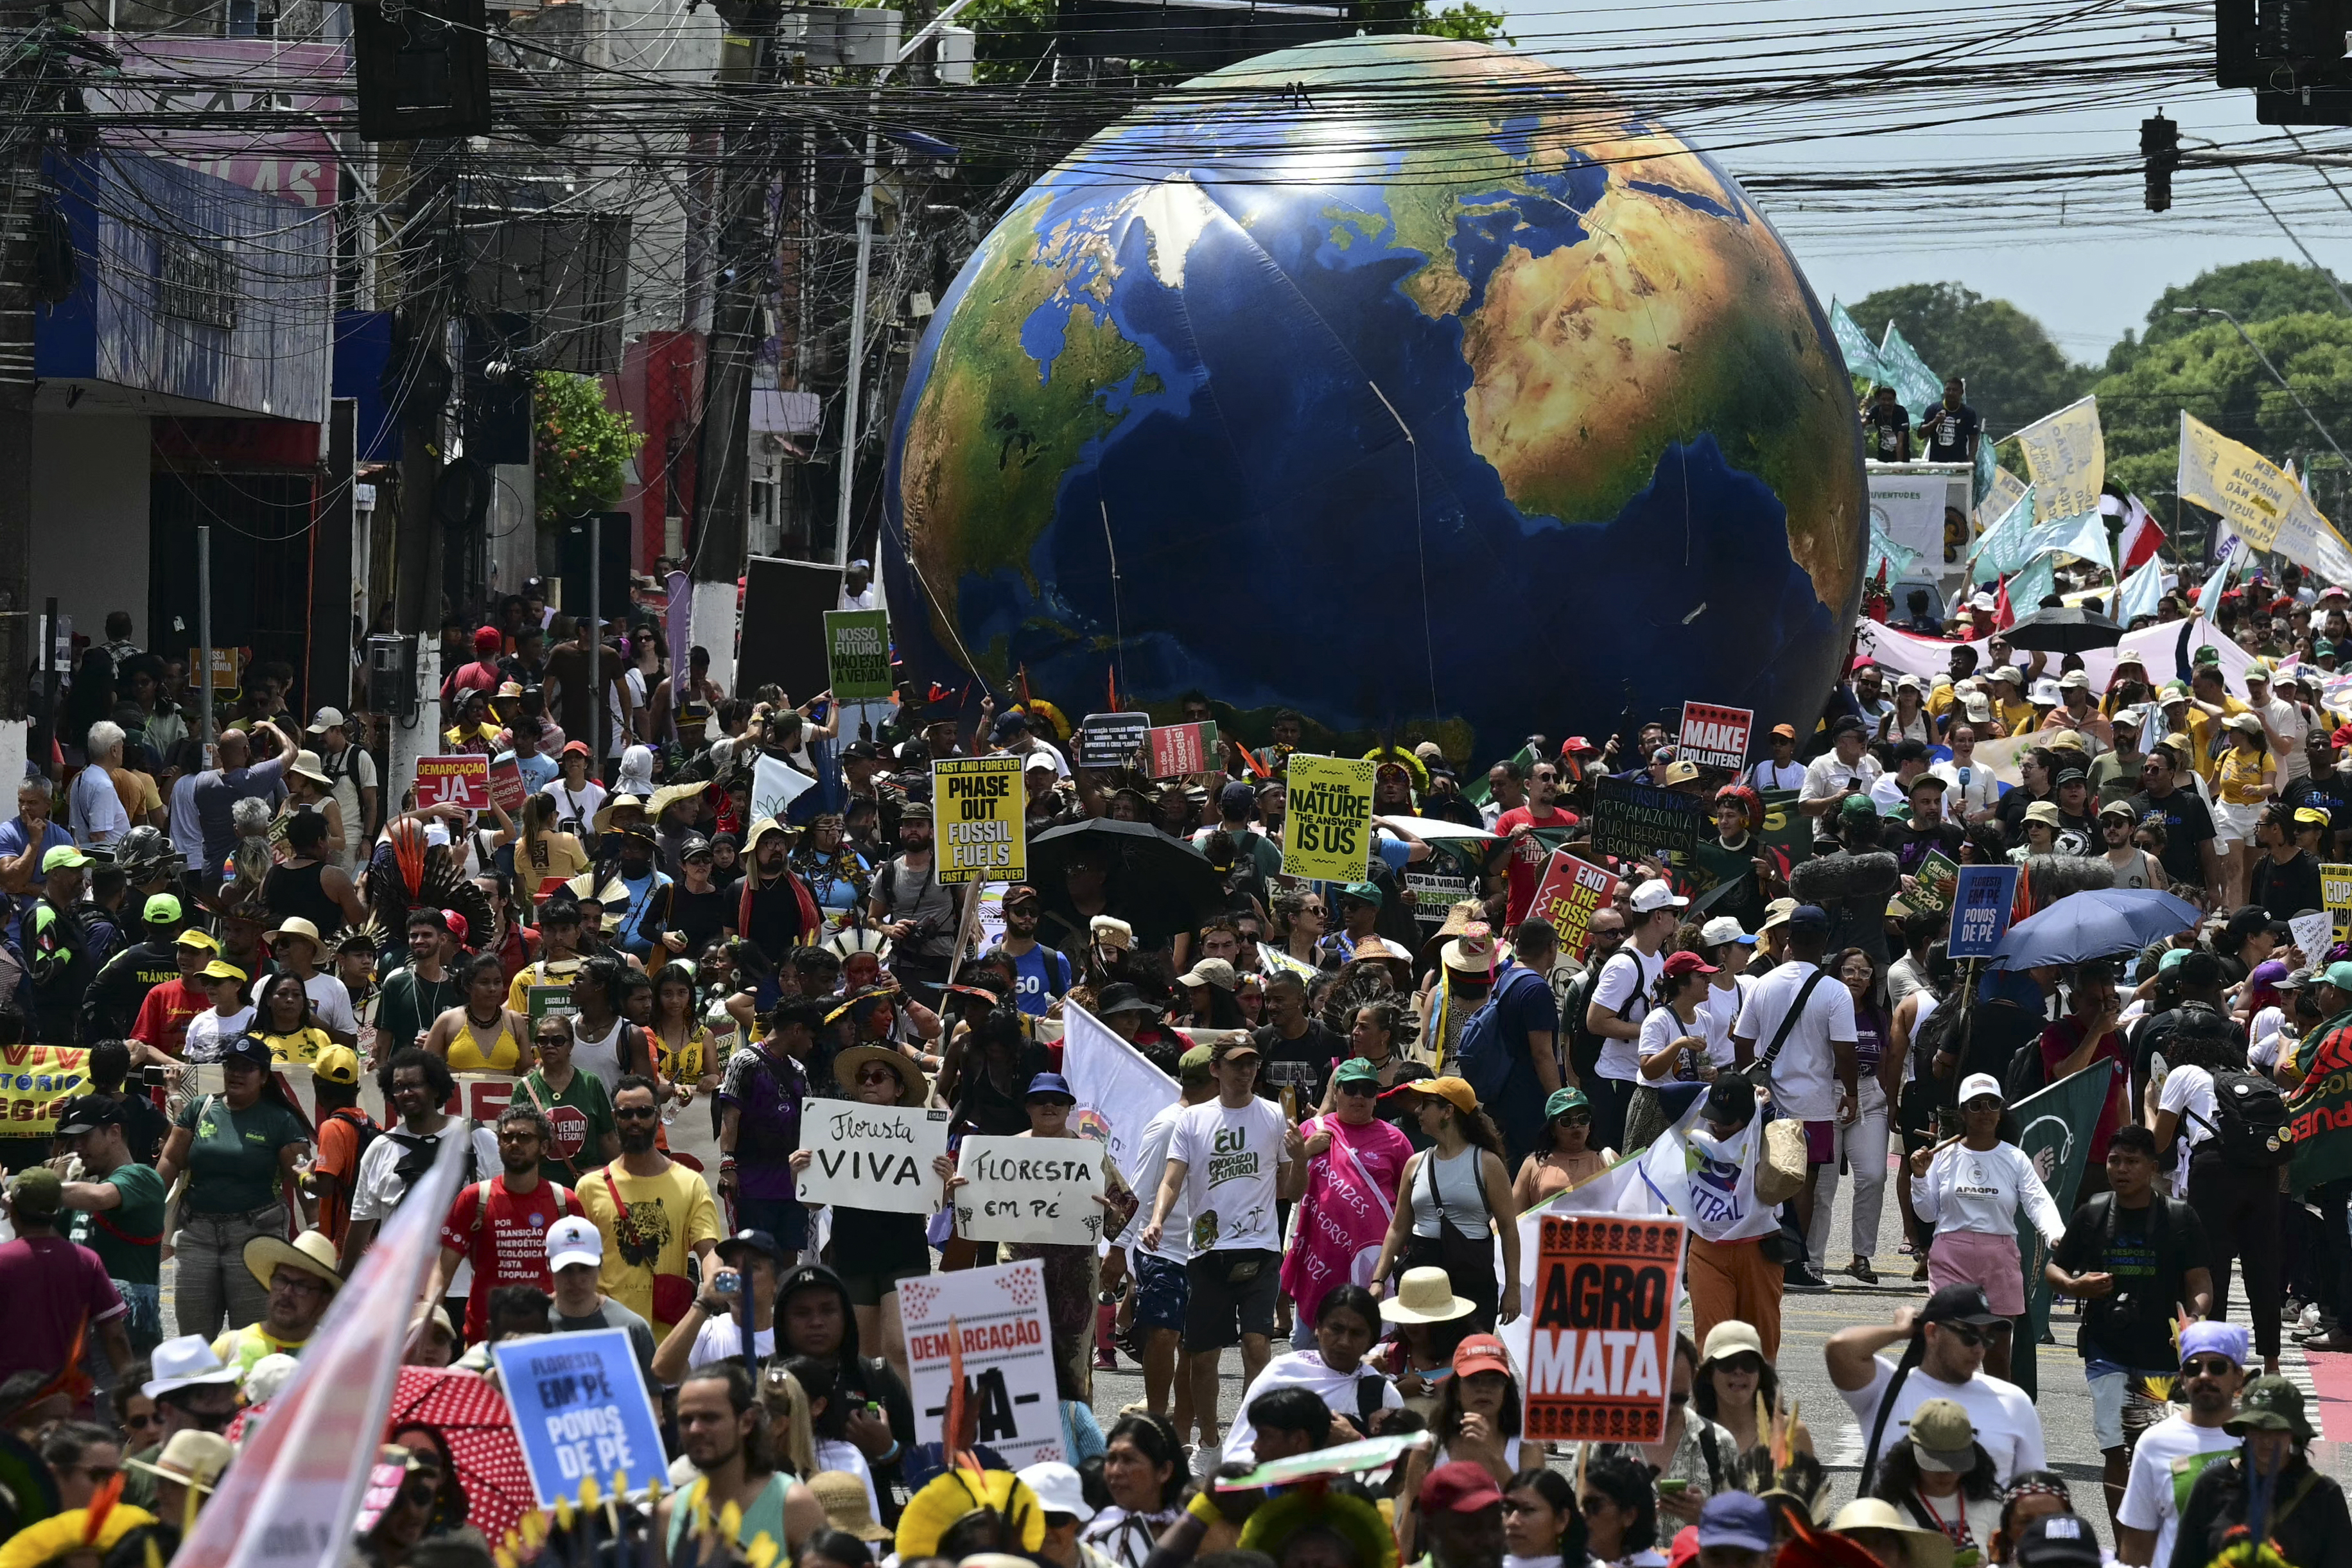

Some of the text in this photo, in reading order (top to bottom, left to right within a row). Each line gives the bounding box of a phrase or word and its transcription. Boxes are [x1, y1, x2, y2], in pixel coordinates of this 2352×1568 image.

[836, 627, 878, 641] NOSSO
[835, 641, 882, 655] FUTURO
[846, 668, 887, 683] VENDA
[1683, 719, 1746, 753] MAKE
[419, 763, 486, 776] DEMARCAÇÃO
[937, 760, 1020, 773] FAST AND FOREVER
[1680, 747, 1741, 769] POLLUTERS
[948, 775, 1009, 798] PHASE
[1311, 781, 1350, 794] WE ARE
[961, 798, 998, 820] OUT
[1290, 789, 1370, 819] NATURE
[1294, 812, 1362, 828] THE ANSWER
[1626, 805, 1693, 830] AMAZONIA
[948, 820, 1013, 845] FOSSIL
[1297, 823, 1355, 855] IS US
[1598, 817, 1693, 849] OUR LIBERATION
[952, 844, 1009, 868] FUELS
[1593, 837, 1650, 858] IS BOUND
[941, 869, 1024, 882] FAST AN OREVER
[1407, 875, 1465, 888] COP DA VIRAD
[1574, 865, 1607, 893] END
[1972, 876, 2002, 887] FLORESTA
[1570, 883, 1601, 910] THE
[2325, 880, 2352, 904] COP
[1549, 896, 1592, 930] FOSS
[1964, 909, 1996, 924] POVOS
[1962, 924, 1976, 942] DE
[2, 1045, 90, 1070] VIV
[830, 1110, 915, 1144] Floresta
[1215, 1126, 1245, 1153] EU
[817, 1149, 920, 1186] VIVA
[971, 1149, 1091, 1182] FLORESTA
[1208, 1152, 1252, 1175] PRODUZO
[495, 1227, 543, 1239] TRANSIÇÃO
[497, 1249, 543, 1257] ECOLÓGICA
[1537, 1263, 1666, 1330] AGRO
[1530, 1329, 1662, 1397] MATA
[546, 1404, 624, 1445] POVOS
[555, 1440, 597, 1479] DE
